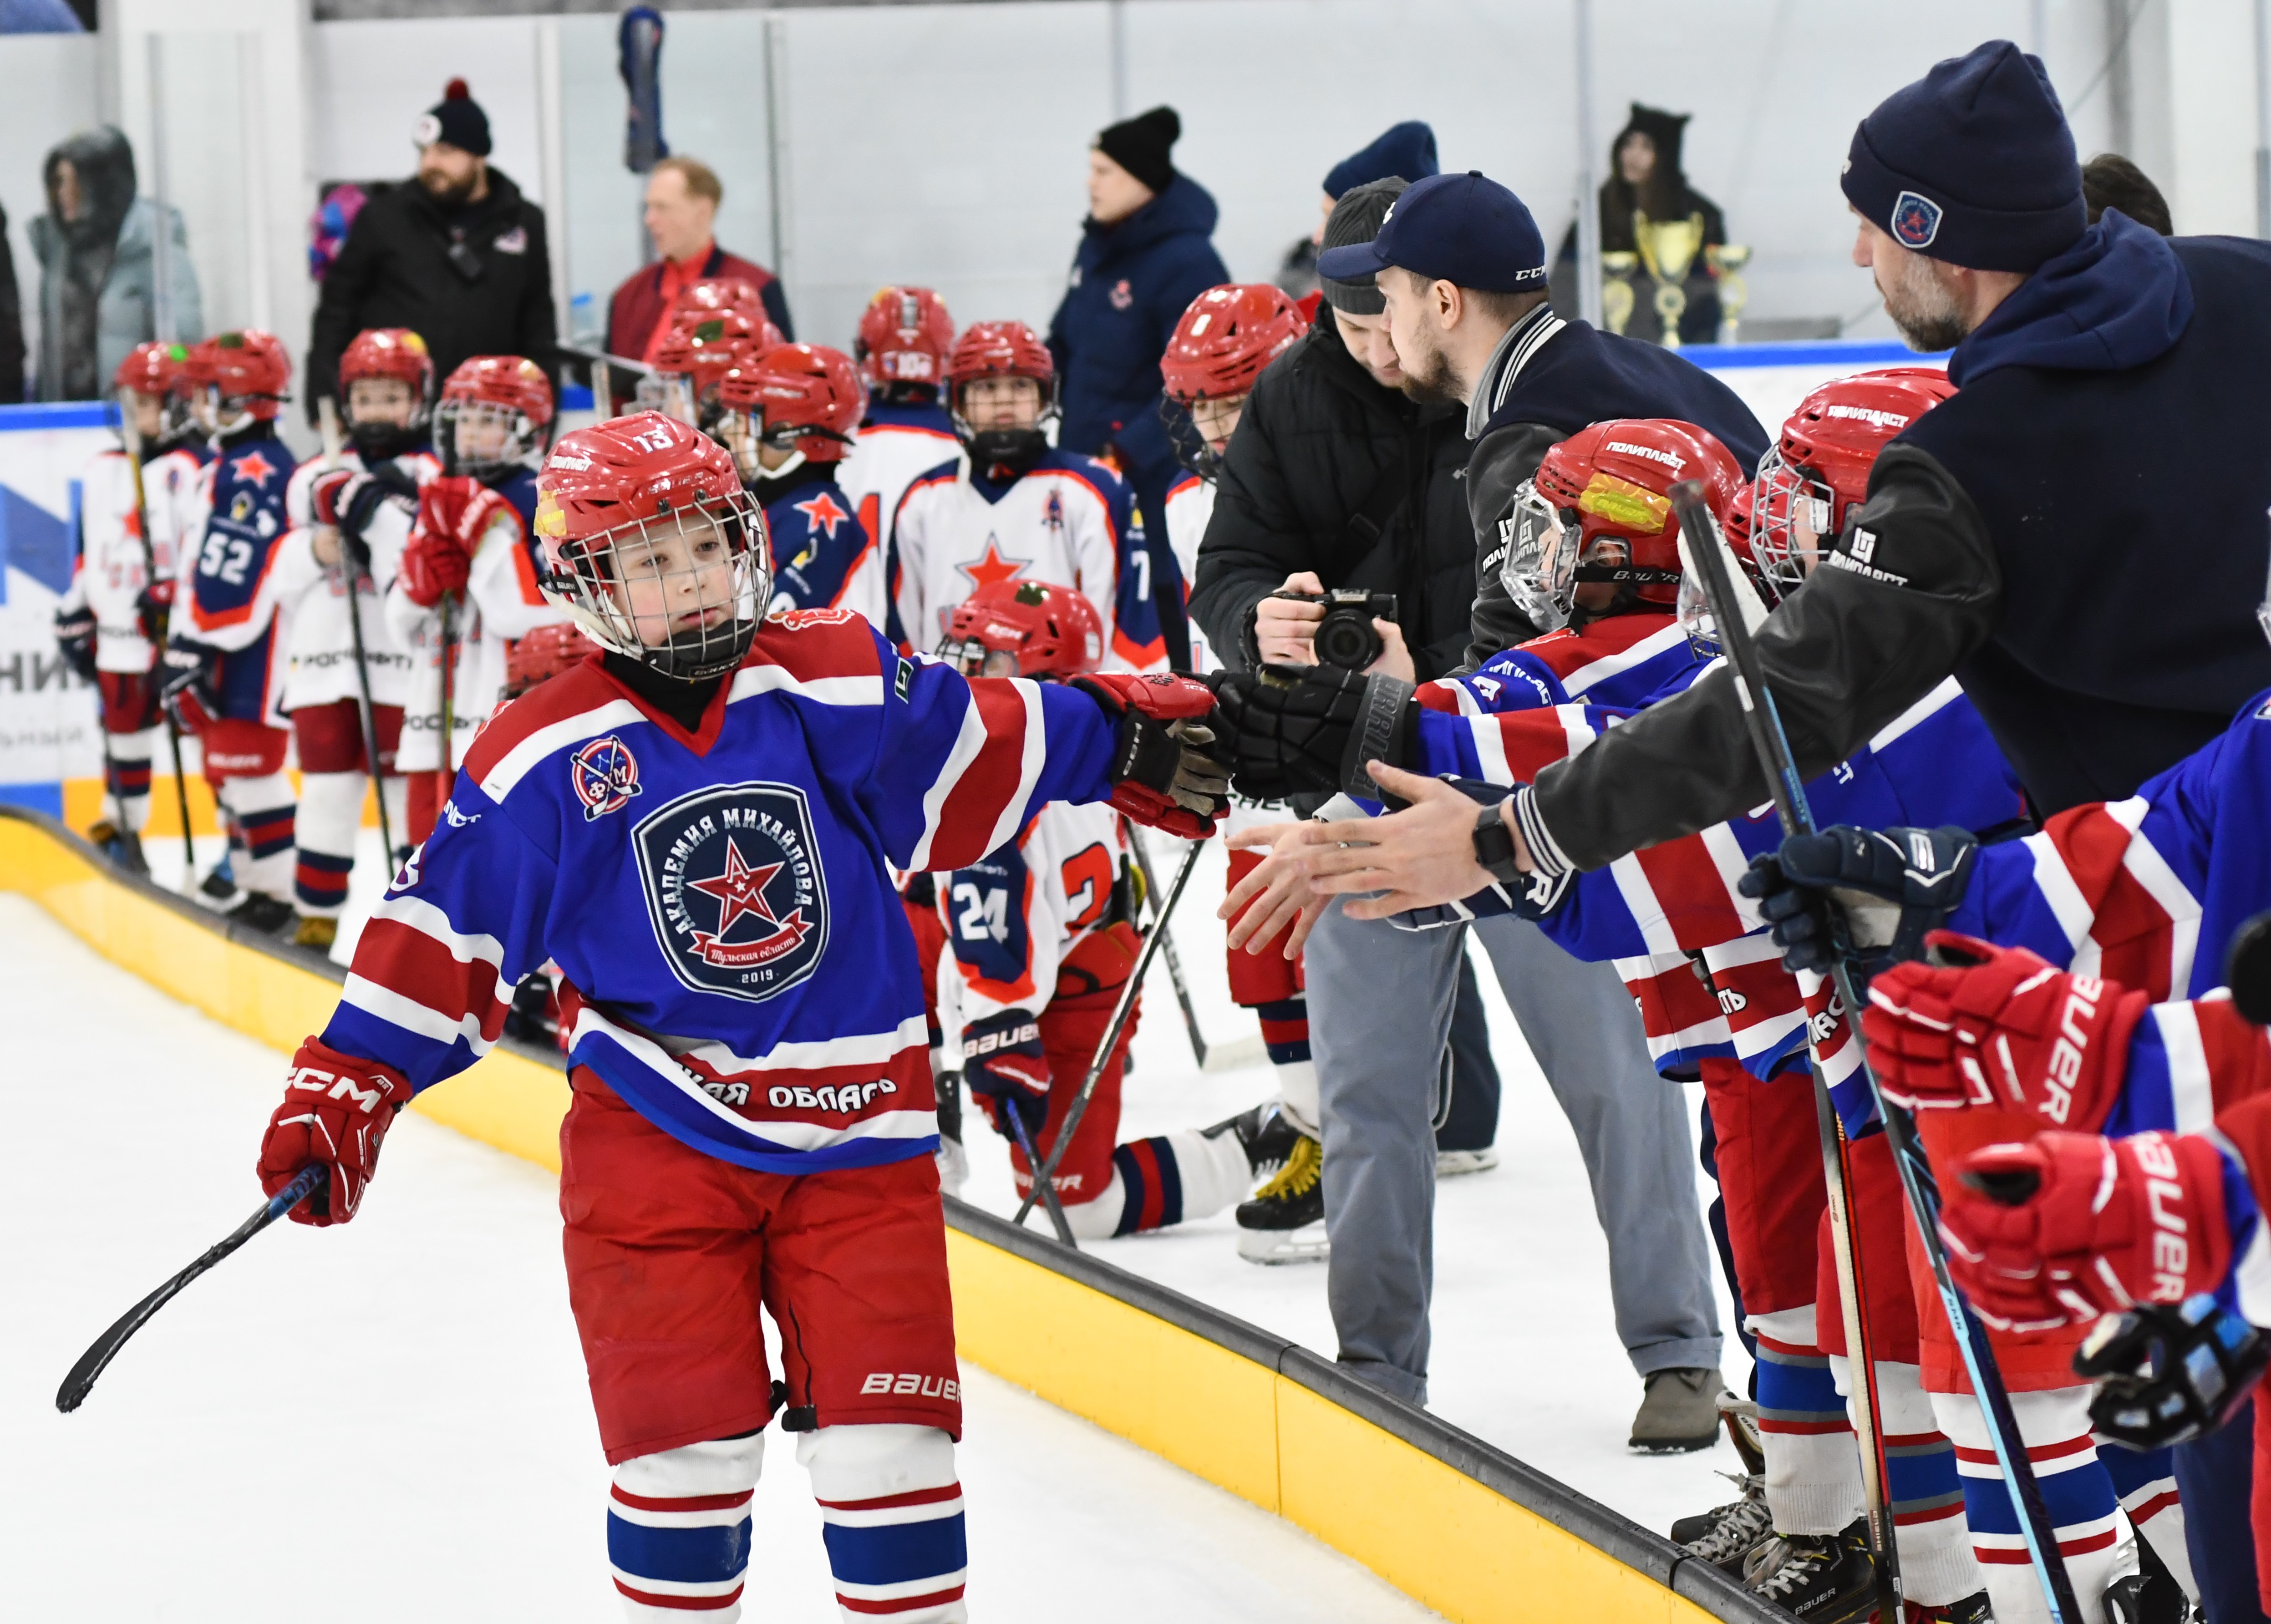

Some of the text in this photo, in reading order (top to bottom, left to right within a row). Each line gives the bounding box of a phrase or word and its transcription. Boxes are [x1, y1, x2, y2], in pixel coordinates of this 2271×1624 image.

[632, 429, 675, 453] 13
[1606, 442, 1687, 470] ПОЛИПЛАСТ
[200, 532, 253, 585] 52
[589, 766, 627, 800] ФХМ
[662, 807, 813, 935] АКАДЕМИЯ МИХАЙЛОВА
[953, 882, 1009, 944] 24
[711, 936, 797, 965] Тульская область
[741, 969, 774, 984] 2019
[2038, 973, 2103, 1124] AUER
[1795, 1587, 1836, 1616] BAUER
